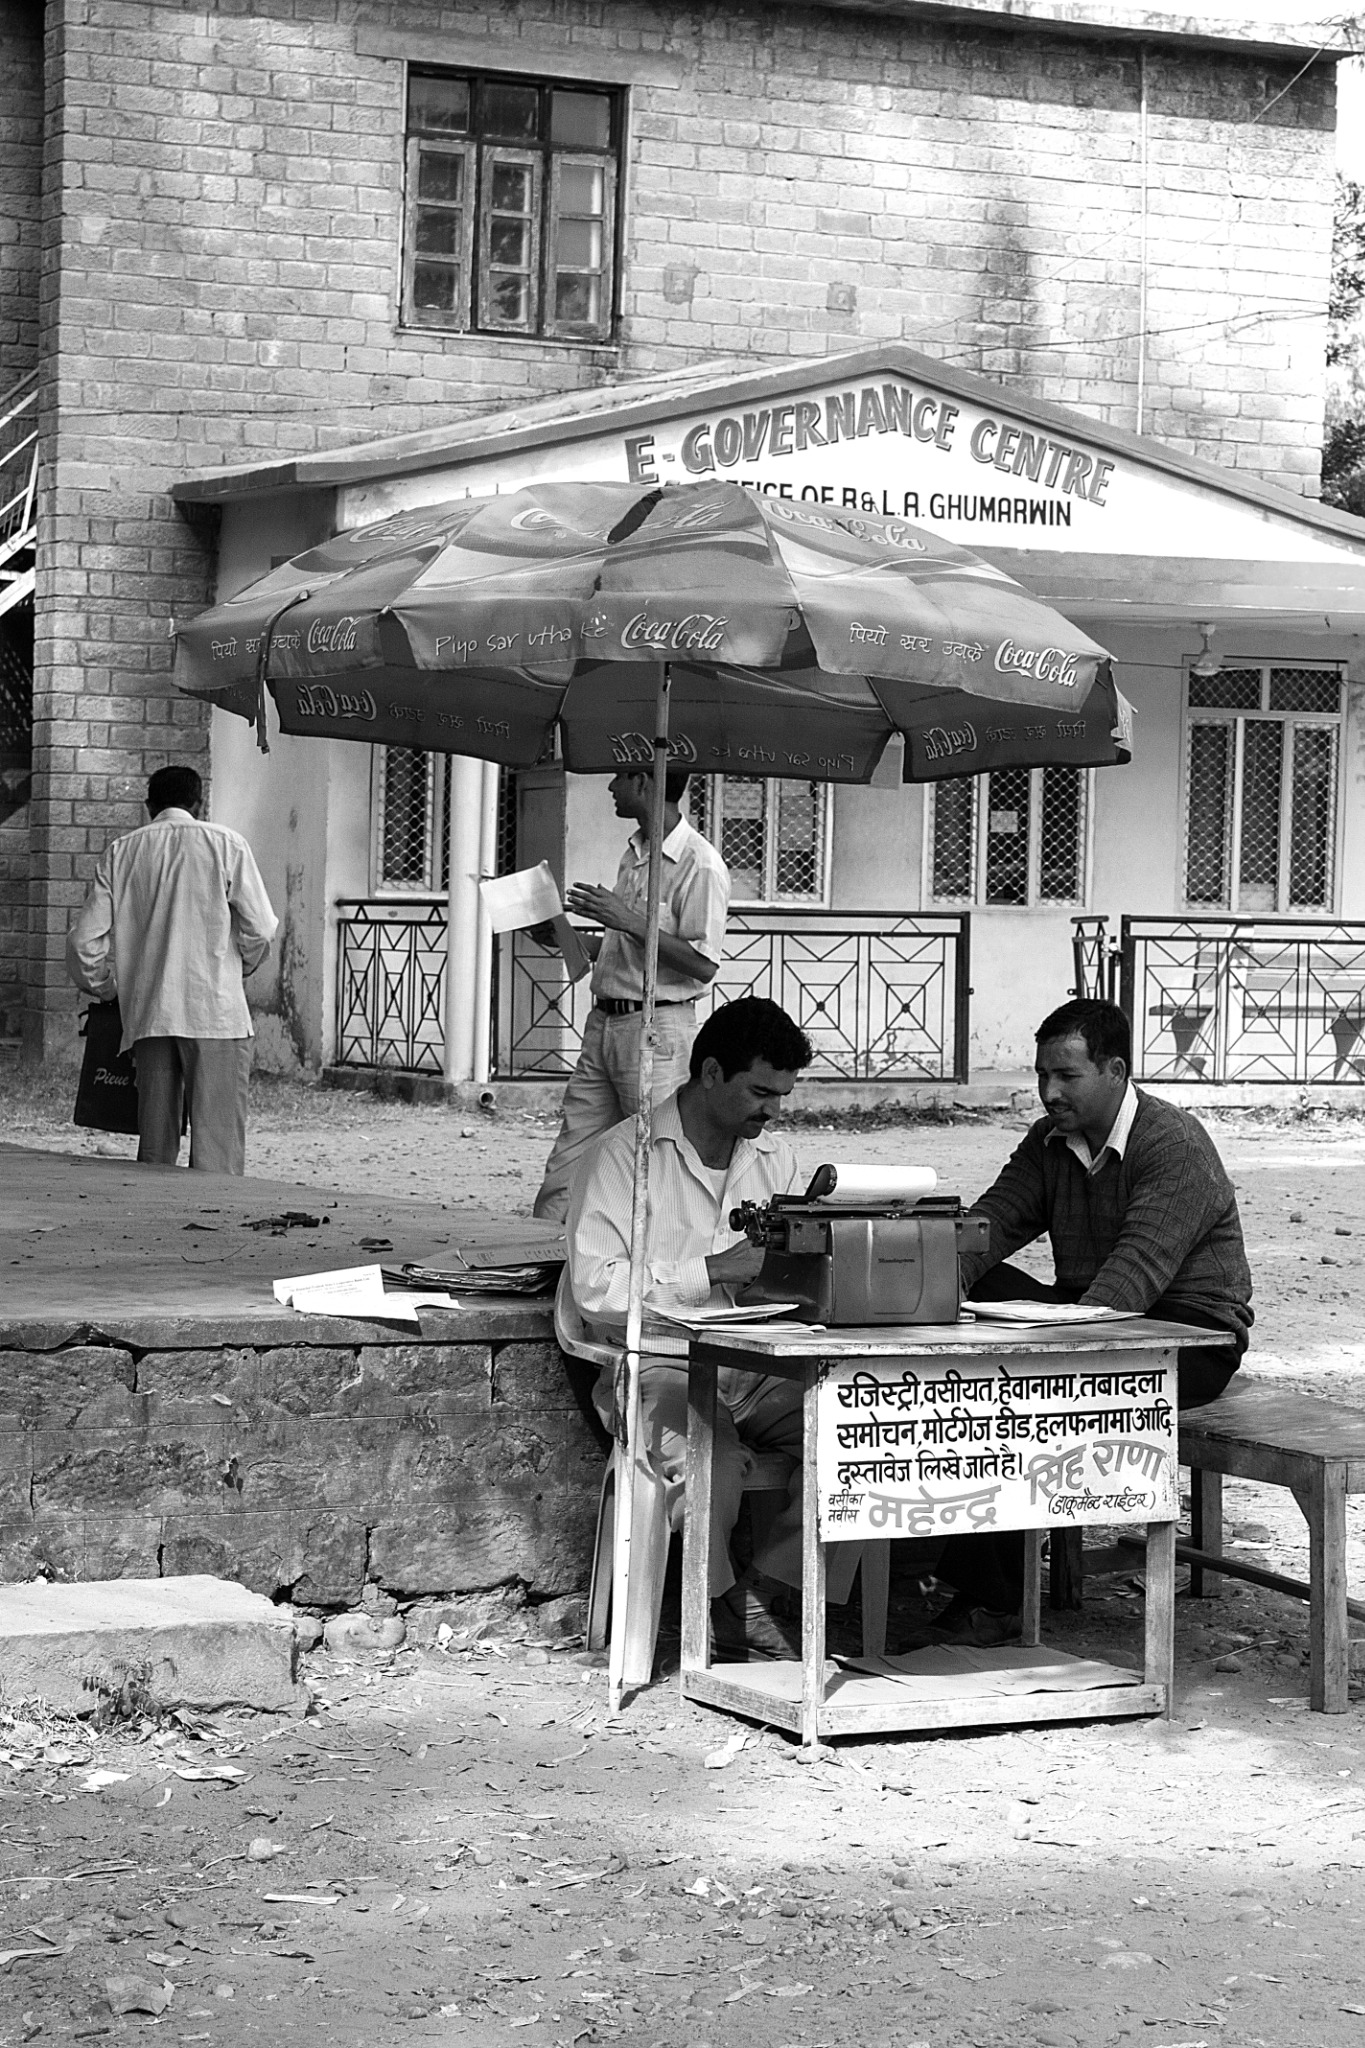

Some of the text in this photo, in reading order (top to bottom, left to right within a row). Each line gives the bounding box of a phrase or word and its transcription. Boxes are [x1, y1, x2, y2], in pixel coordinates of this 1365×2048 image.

[970, 418, 1115, 506] CENTRE
[929, 493, 1071, 526] GHUMARWIN
[307, 616, 362, 653] Coca-Cola
[435, 635, 478, 662] Piyo
[486, 632, 520, 652] sar
[528, 624, 572, 647] utha
[621, 612, 729, 650] Coca-Cola
[850, 622, 890, 646] पियो
[900, 634, 932, 653] सर
[994, 638, 1080, 687] Coca-Cola
[868, 1439, 1167, 1536] महेन्द्र सिंह राणा
